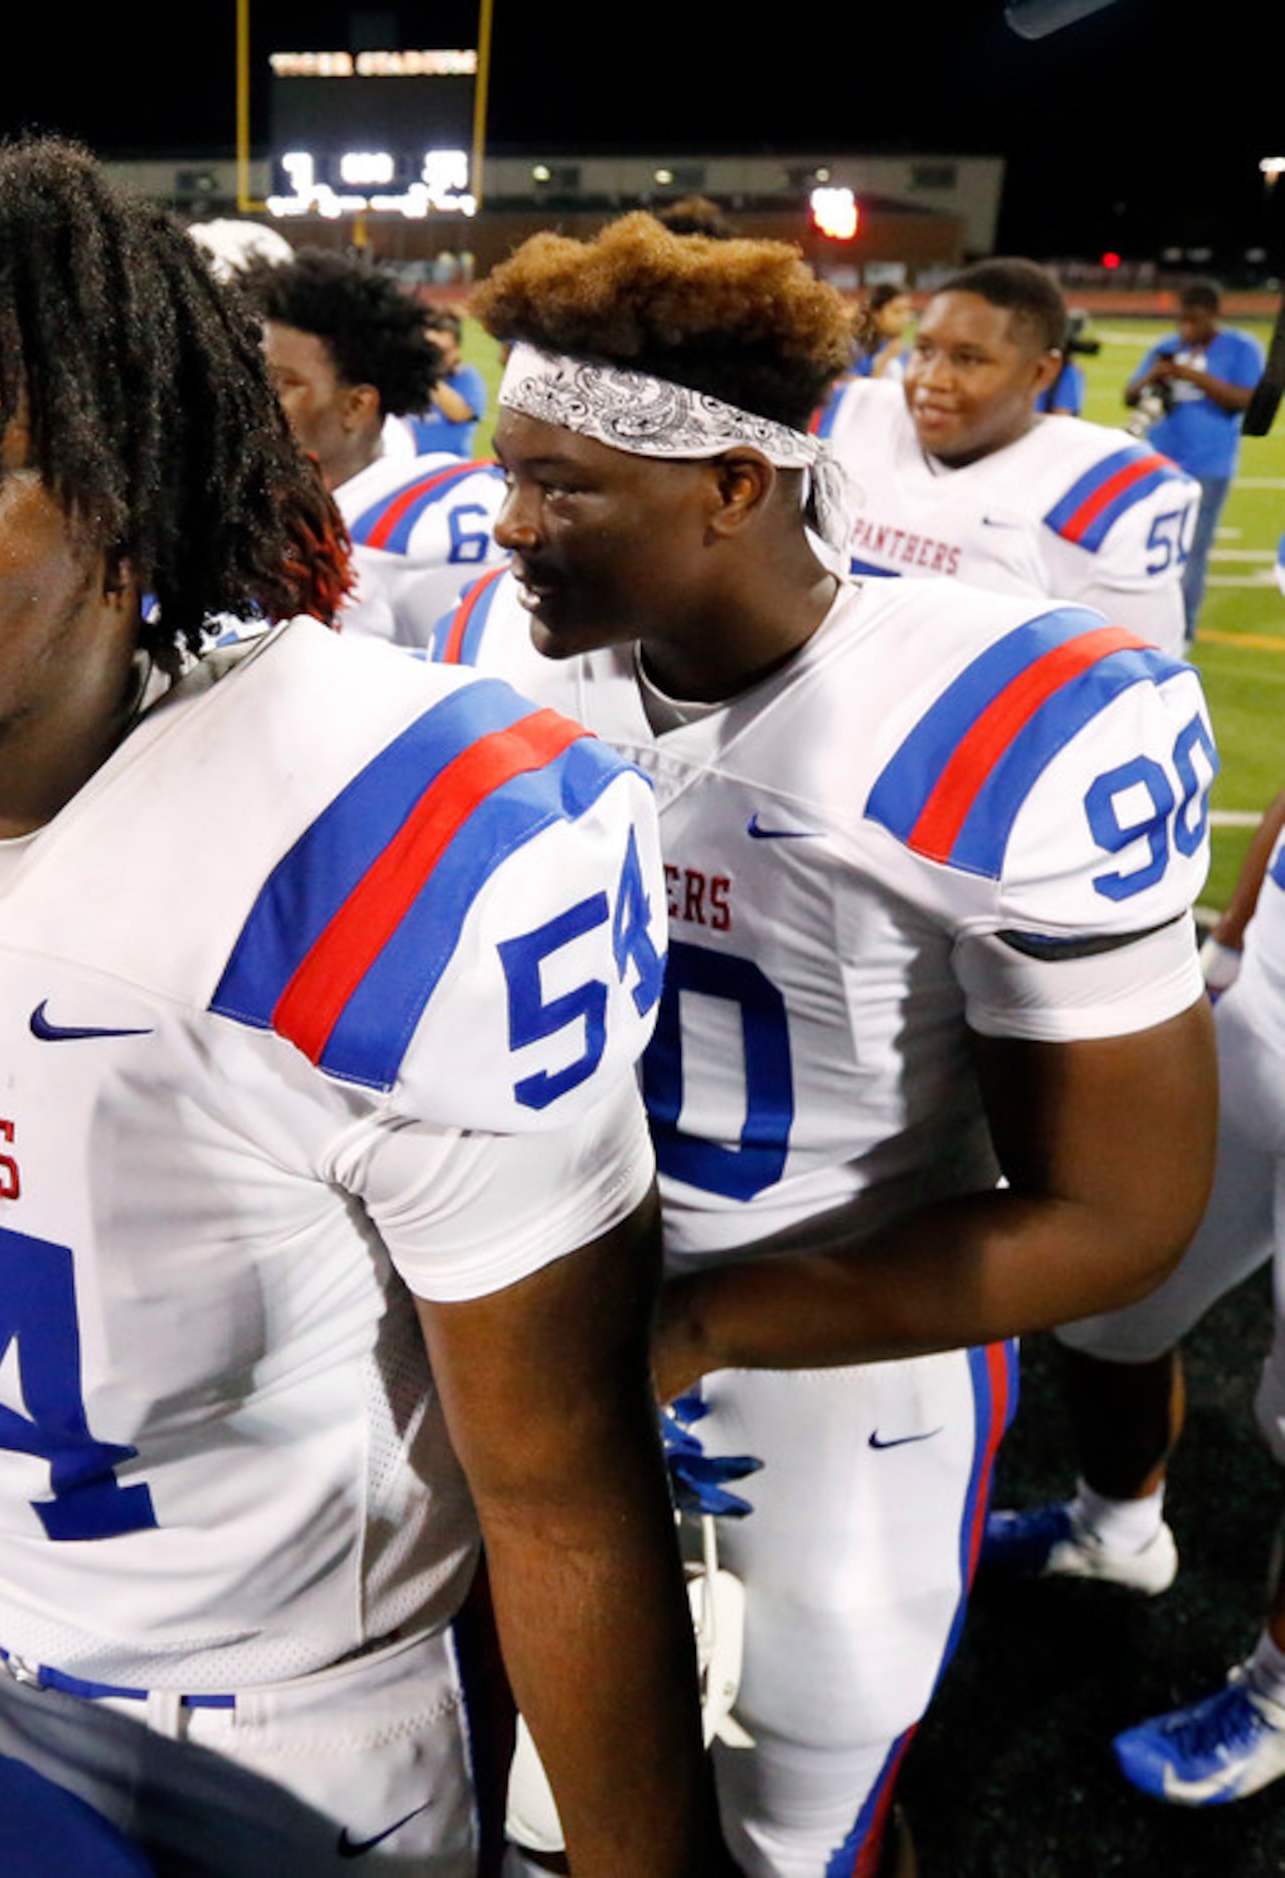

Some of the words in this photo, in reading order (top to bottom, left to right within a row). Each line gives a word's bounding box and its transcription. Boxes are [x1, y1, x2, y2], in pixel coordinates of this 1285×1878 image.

[447, 504, 512, 564] 6
[850, 518, 962, 576] PANTHERS
[1083, 711, 1219, 902] 90
[496, 823, 668, 1111] 54
